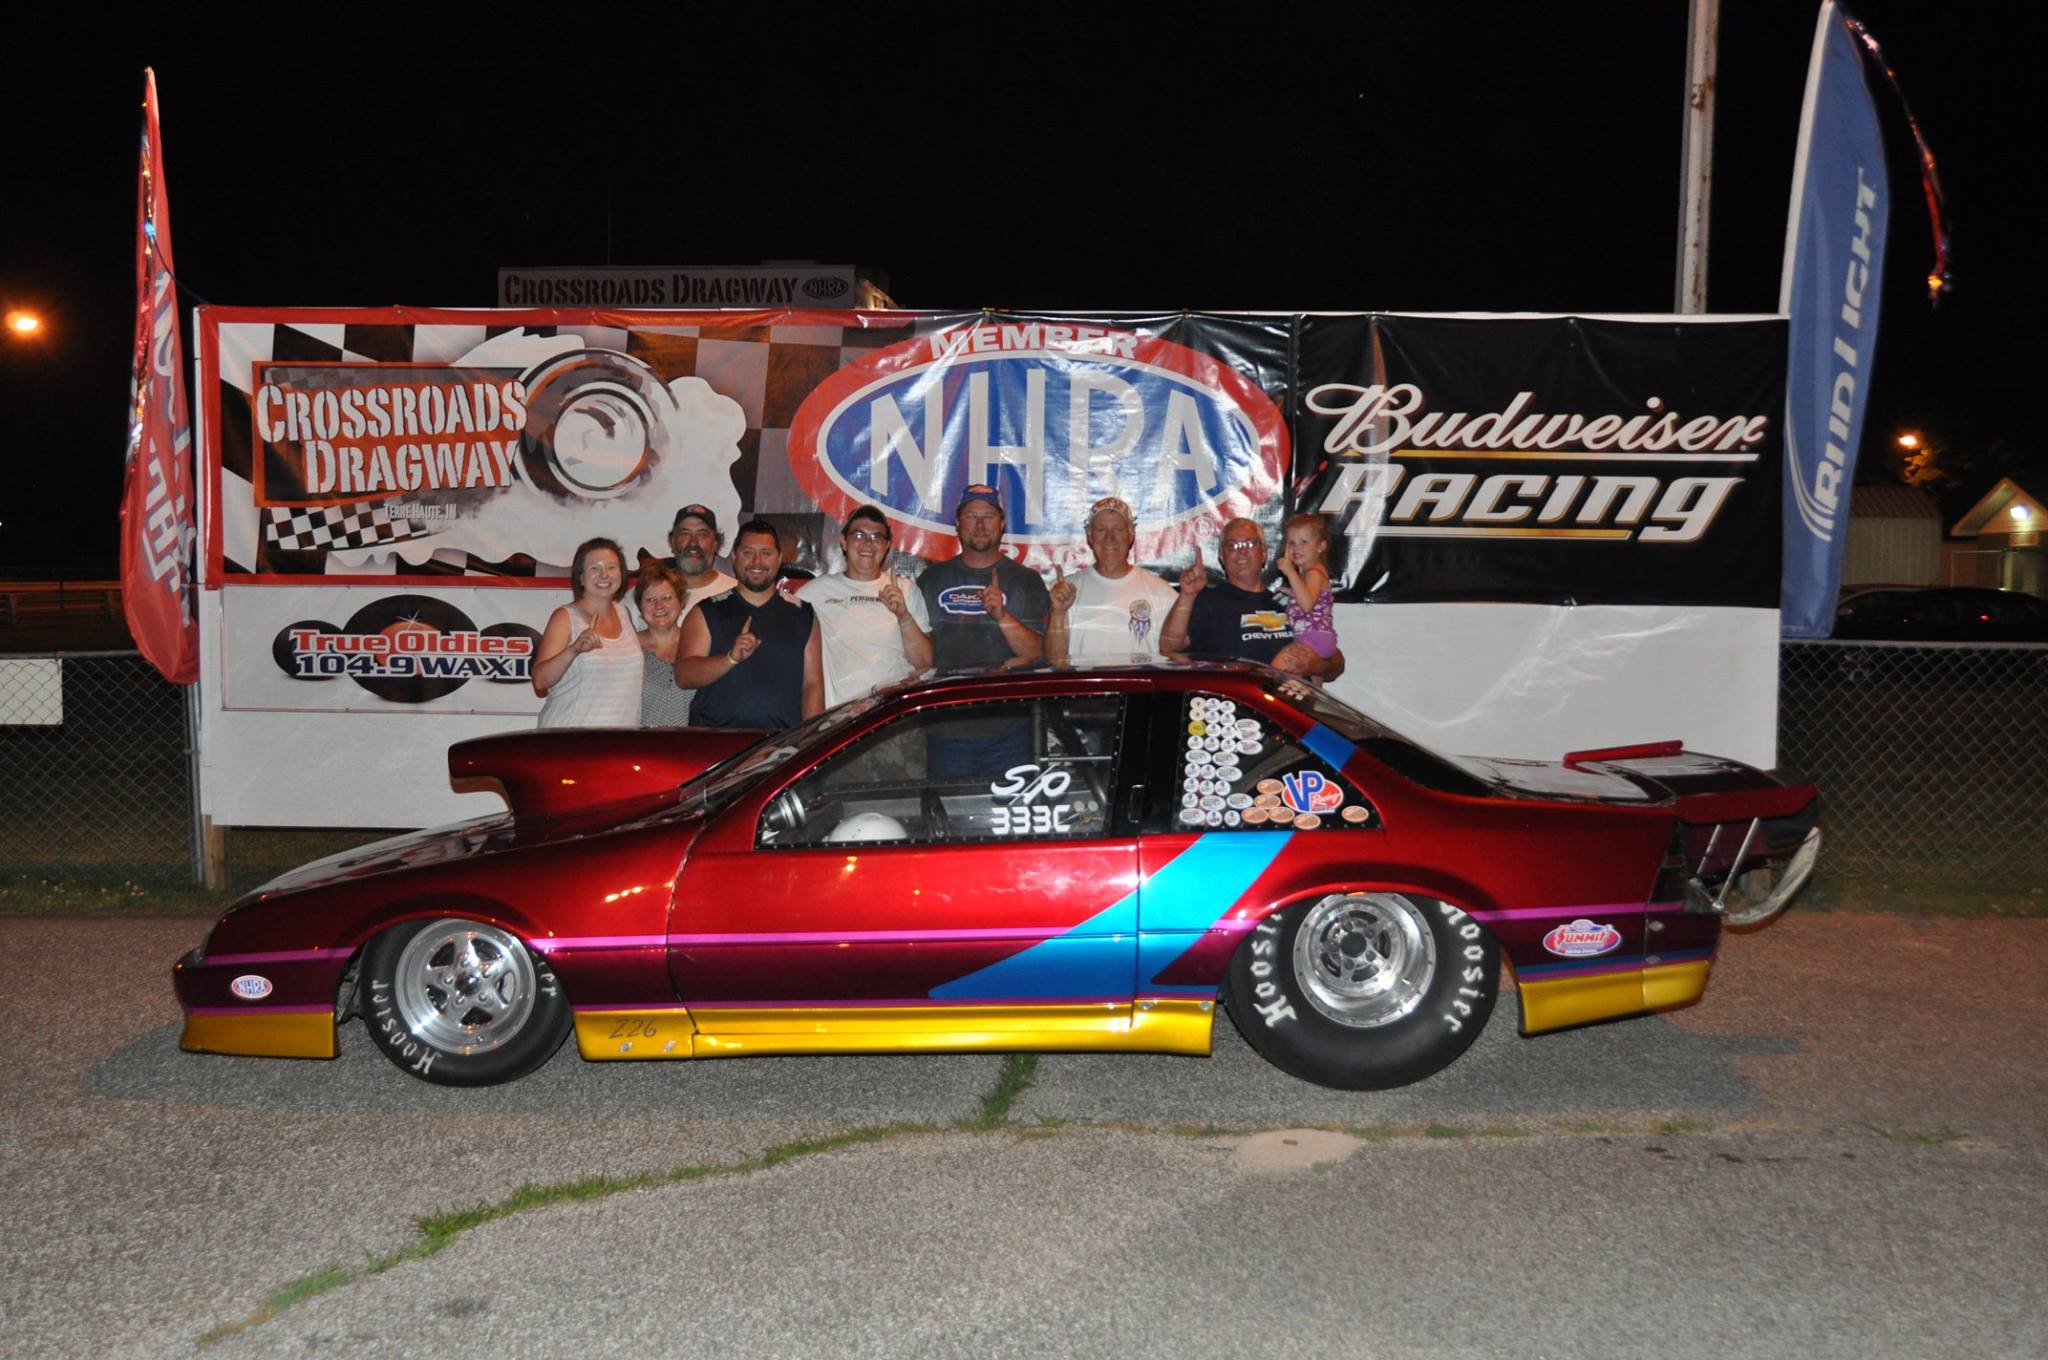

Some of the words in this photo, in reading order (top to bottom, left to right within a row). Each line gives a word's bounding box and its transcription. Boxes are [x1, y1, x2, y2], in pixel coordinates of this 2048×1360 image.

[504, 274, 665, 305] CROSSROADS
[672, 273, 798, 304] DRAGWAY
[929, 325, 1138, 359] MEMBER
[256, 381, 527, 443] CROSSROADS
[1305, 383, 1768, 455] Budweiser
[869, 368, 1217, 525] NHRA
[306, 440, 519, 494] DRAGWAY
[384, 503, 411, 519] TERRE
[445, 503, 457, 519] IN
[292, 630, 388, 653] True
[397, 631, 531, 655] Oldies
[1241, 632, 1272, 641] CHEVY
[298, 655, 415, 675] 104.9
[420, 657, 529, 677] WAXI
[1282, 770, 1325, 813] VP
[991, 804, 1072, 836] 333C
[238, 979, 266, 994] NHRA
